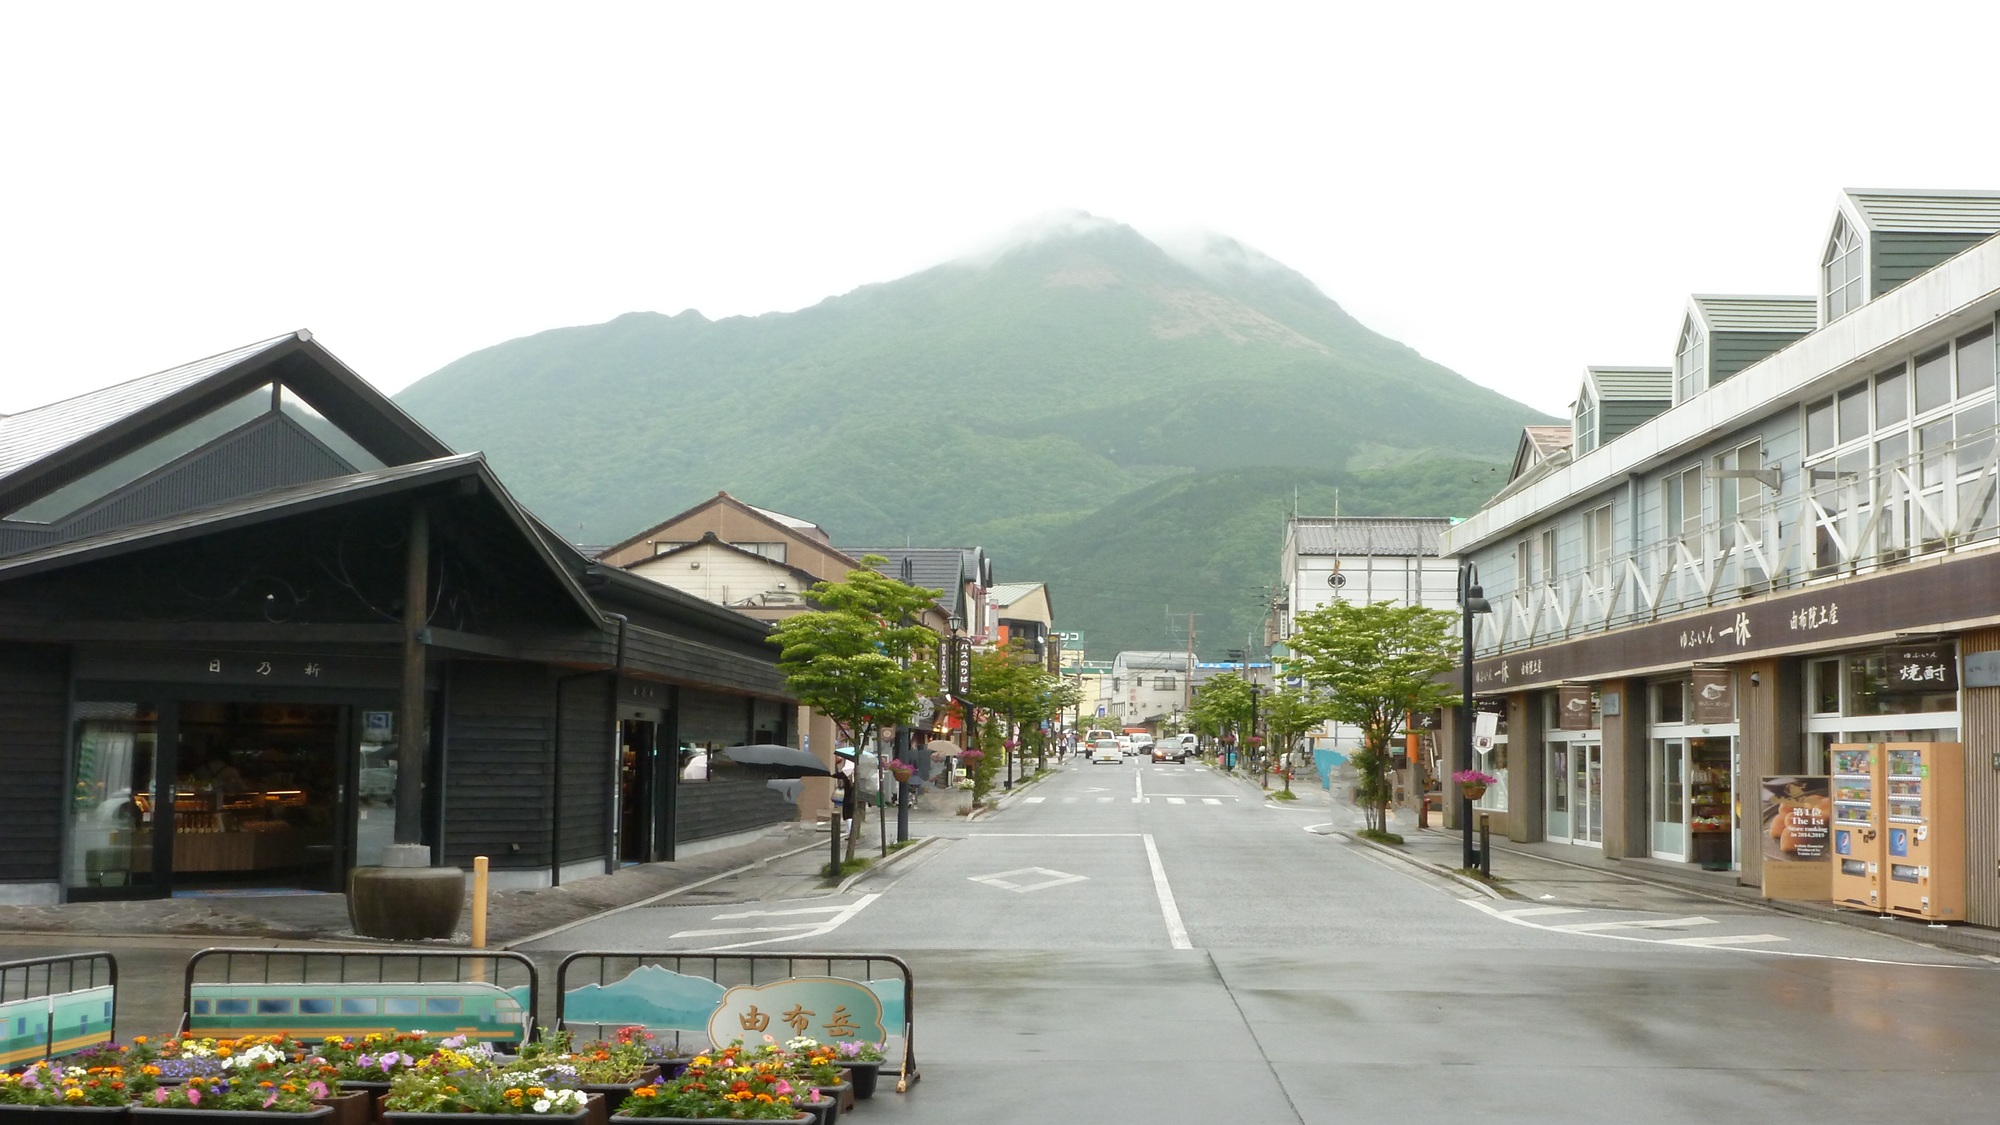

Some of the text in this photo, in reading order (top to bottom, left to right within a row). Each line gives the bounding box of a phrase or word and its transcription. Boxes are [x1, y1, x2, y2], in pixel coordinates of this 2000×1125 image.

[1680, 602, 1839, 649] ゆふいん 一休 由布院土産
[960, 643, 969, 683] バスのりば
[1900, 663, 1946, 681] 焼酎
[1791, 817, 1824, 825] The 1st
[739, 1003, 861, 1037] 由布岳
